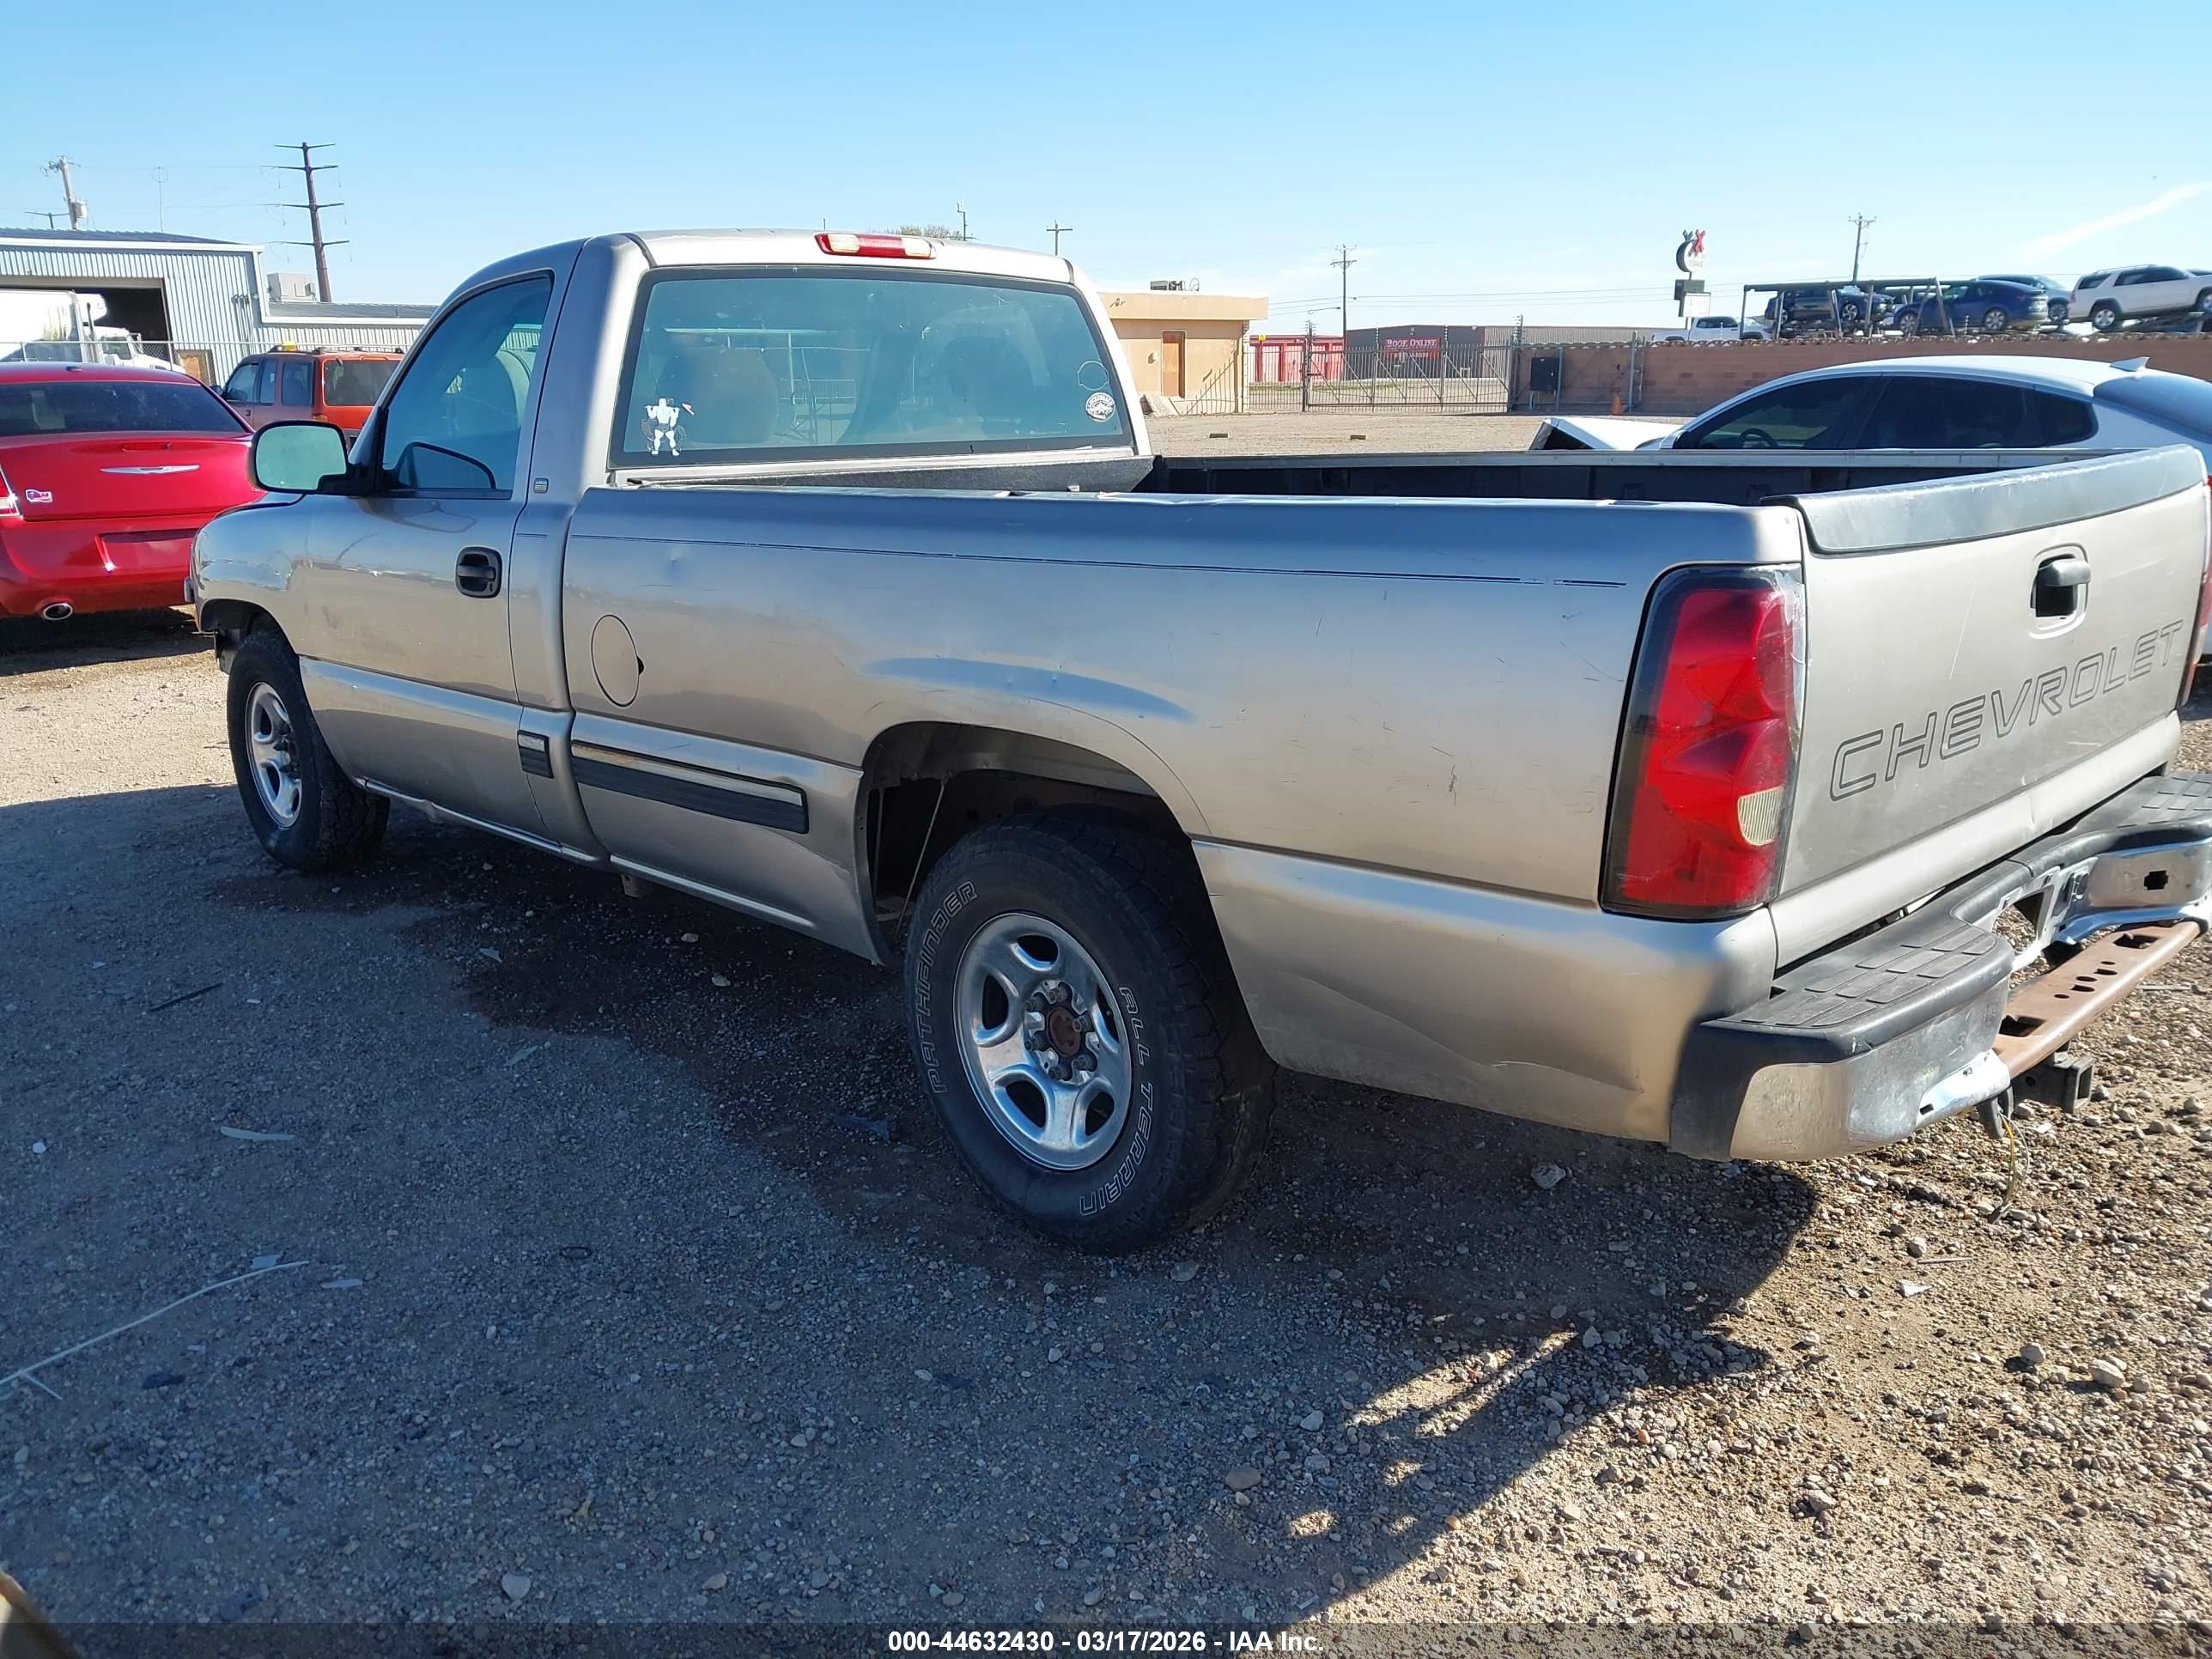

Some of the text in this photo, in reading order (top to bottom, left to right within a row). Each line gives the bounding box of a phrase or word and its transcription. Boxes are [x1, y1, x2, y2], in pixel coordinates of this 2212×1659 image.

[1409, 338, 1437, 348] ONLINE
[1830, 619, 2184, 802] CHEVROLET
[915, 880, 978, 1094] PATHFINDER
[1079, 987, 1154, 1216] ALL TERRAIN
